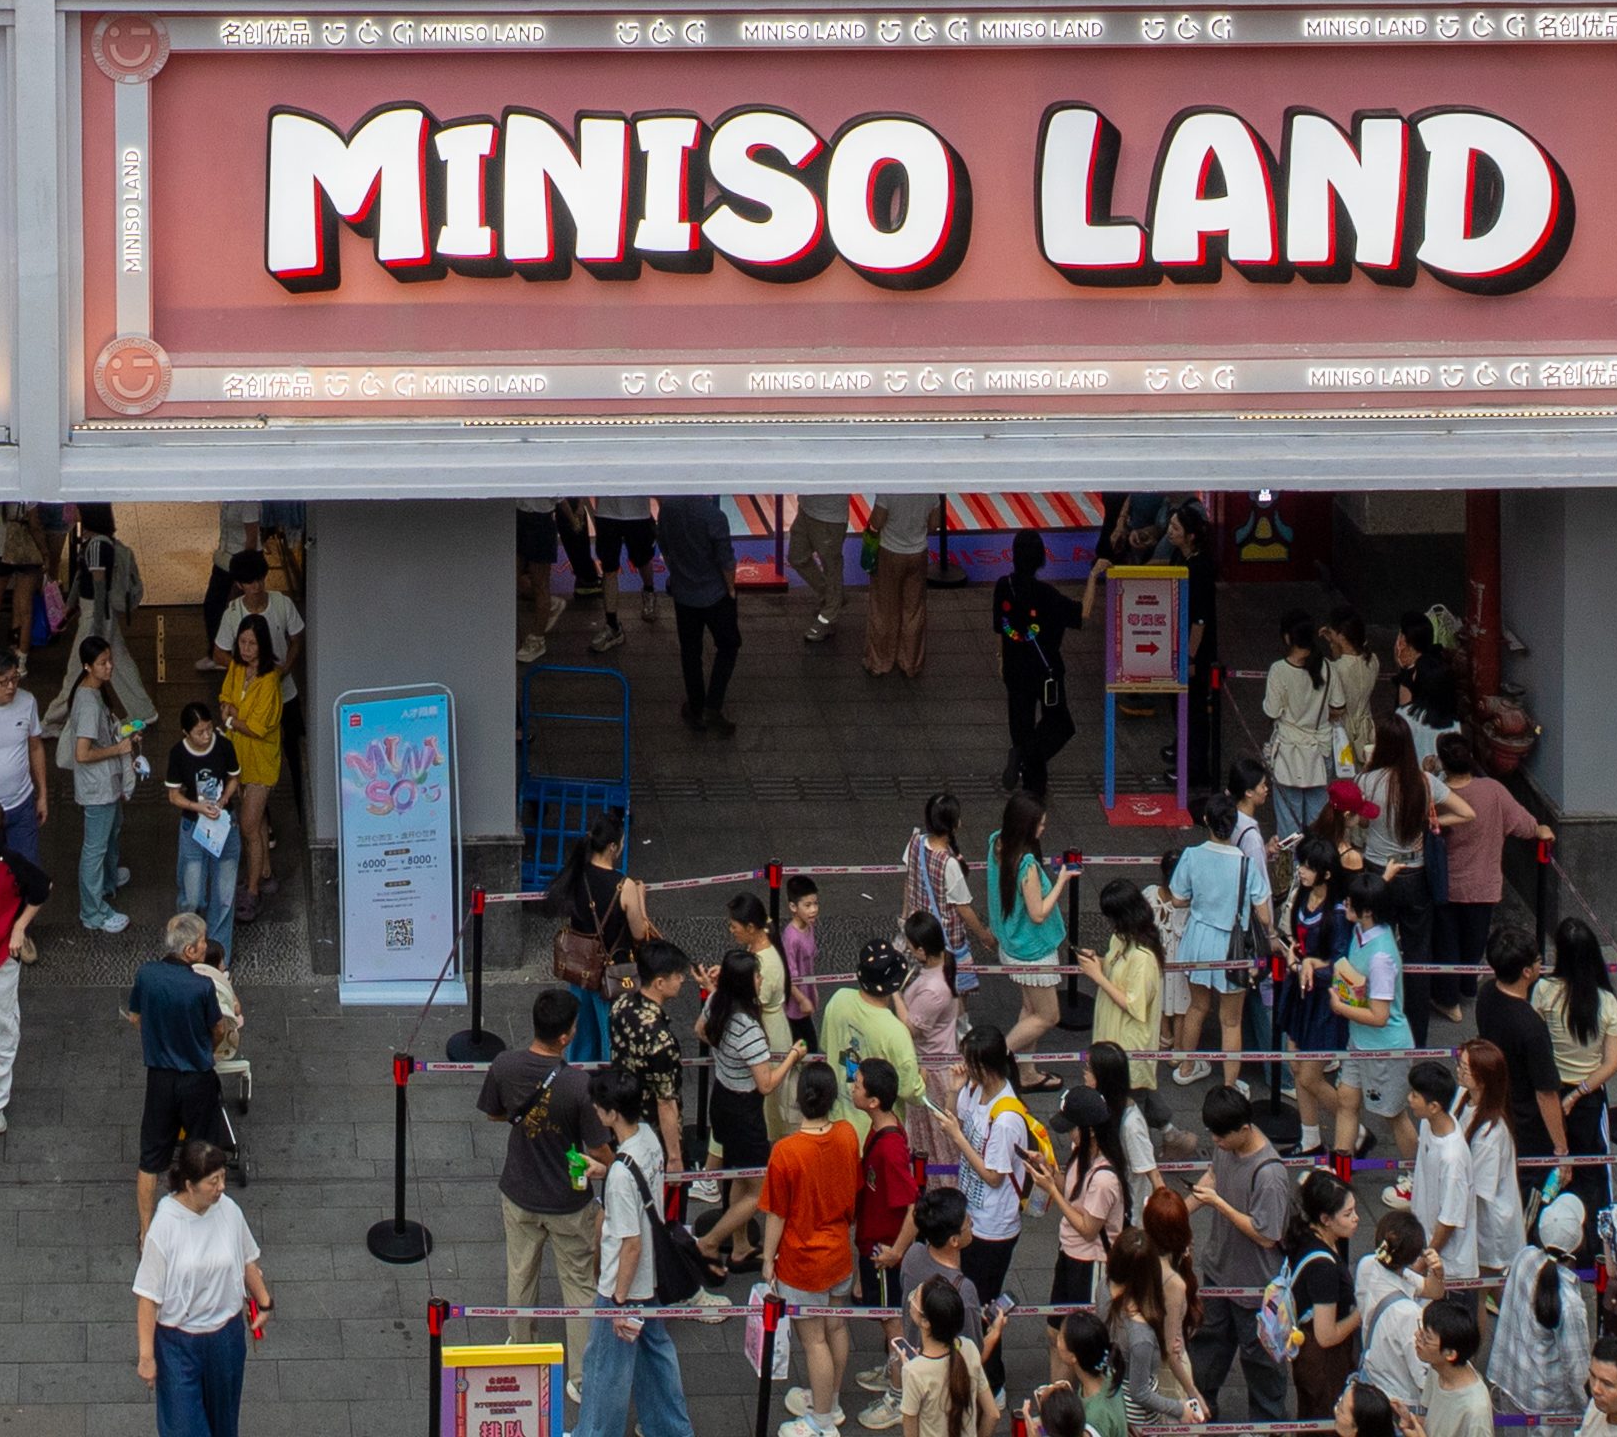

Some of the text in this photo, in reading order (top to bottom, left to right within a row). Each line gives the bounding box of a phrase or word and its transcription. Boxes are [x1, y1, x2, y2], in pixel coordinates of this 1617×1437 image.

[220, 21, 311, 46] 名创优品
[421, 23, 545, 44] MINISO LAND
[1305, 18, 1427, 37] MINISO LAND
[267, 100, 1576, 295] MINISO LAND
[124, 149, 140, 272] MINISO LAND
[224, 374, 313, 398] 名创优品
[750, 372, 872, 392] MINISO LAND
